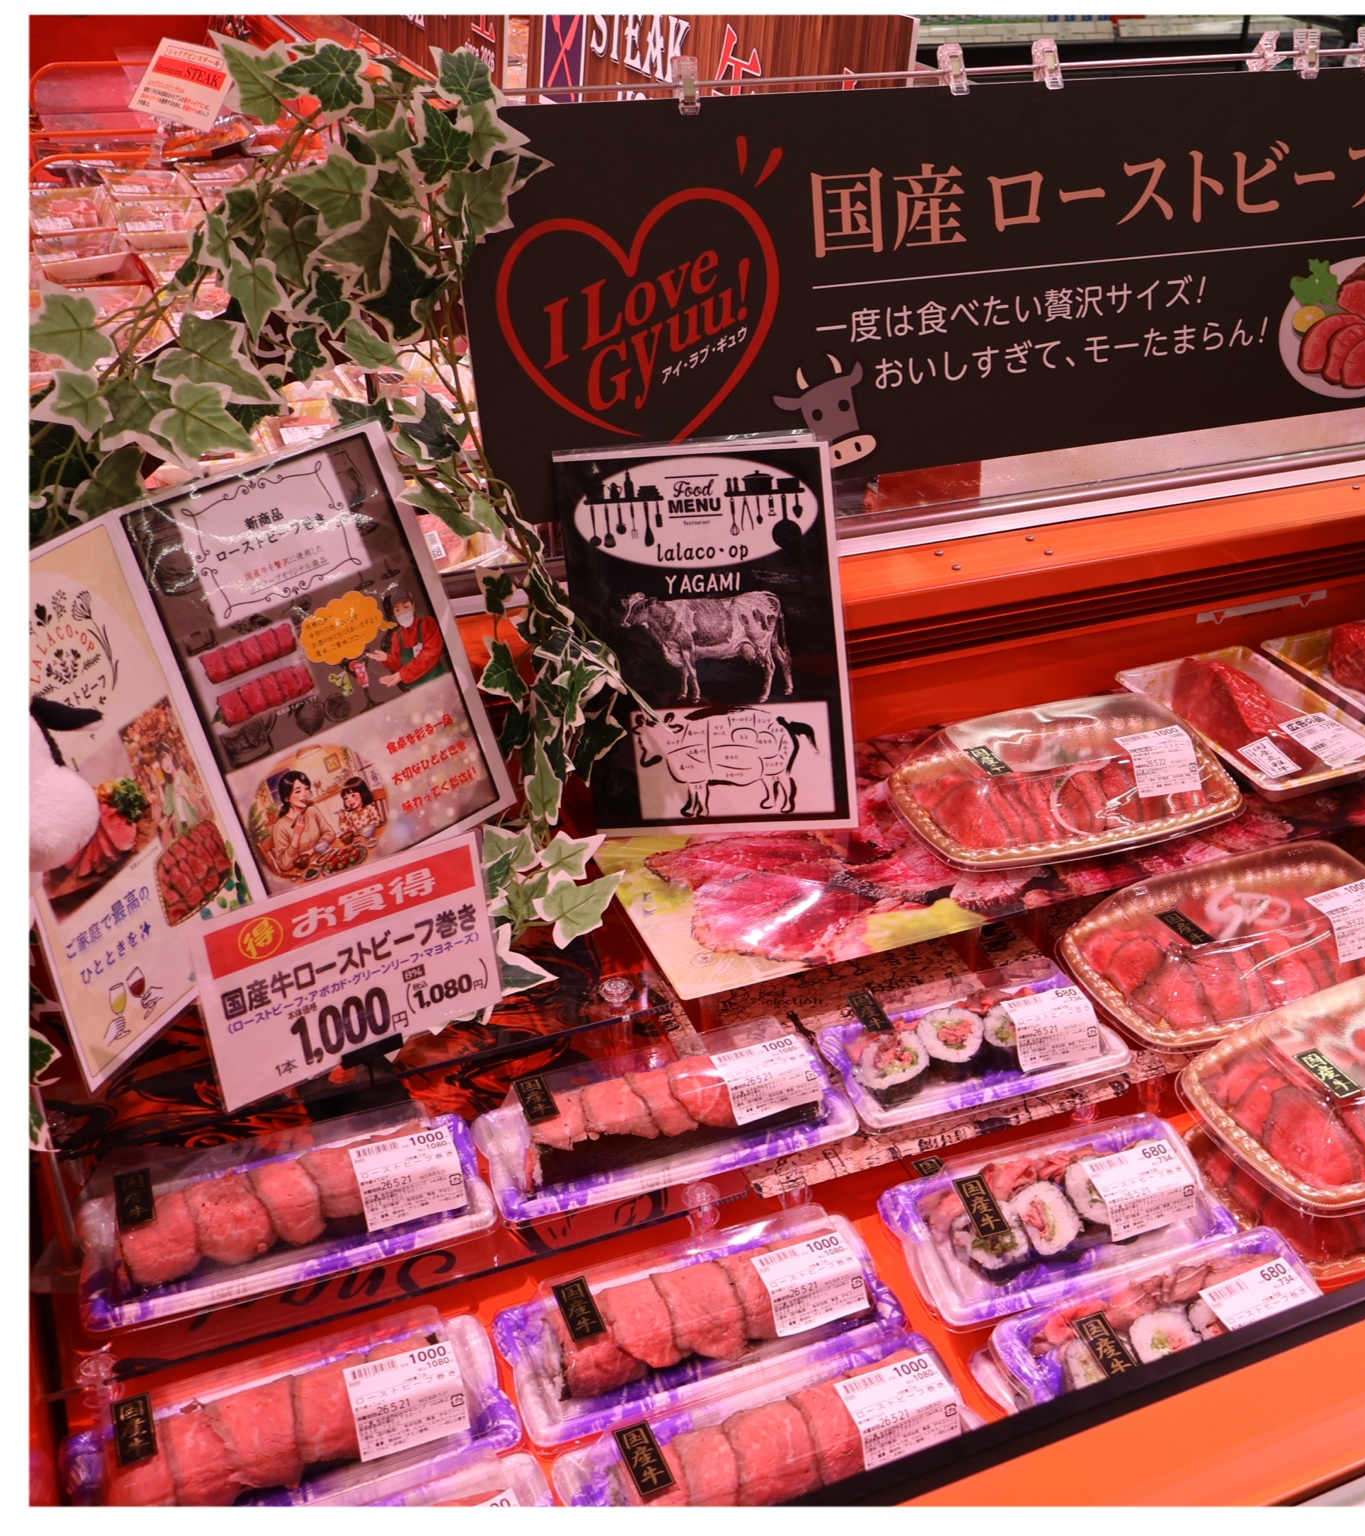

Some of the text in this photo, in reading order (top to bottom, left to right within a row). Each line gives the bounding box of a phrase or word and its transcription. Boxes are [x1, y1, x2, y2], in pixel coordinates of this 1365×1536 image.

[184, 66, 221, 88] STEAK
[809, 162, 968, 259] 国産
[544, 248, 721, 371] I Love
[585, 256, 752, 414] Gyuu!
[661, 324, 750, 386] アイ・ラブ・ギュウ
[667, 497, 722, 514] MENU
[672, 479, 715, 498] Food
[244, 507, 284, 531] 新商品
[664, 571, 741, 595] YAGAMI
[385, 713, 454, 756] 食卓を彩る一品
[391, 740, 468, 786] 大切なひとときを
[66, 885, 151, 960] ご家庭で最高の
[291, 866, 436, 940] お買得
[220, 904, 477, 1021] 国産牛ローストビーフ巻き
[274, 1059, 298, 1077] 1本
[409, 1131, 444, 1147] 1000
[1141, 1143, 1168, 1161] 680
